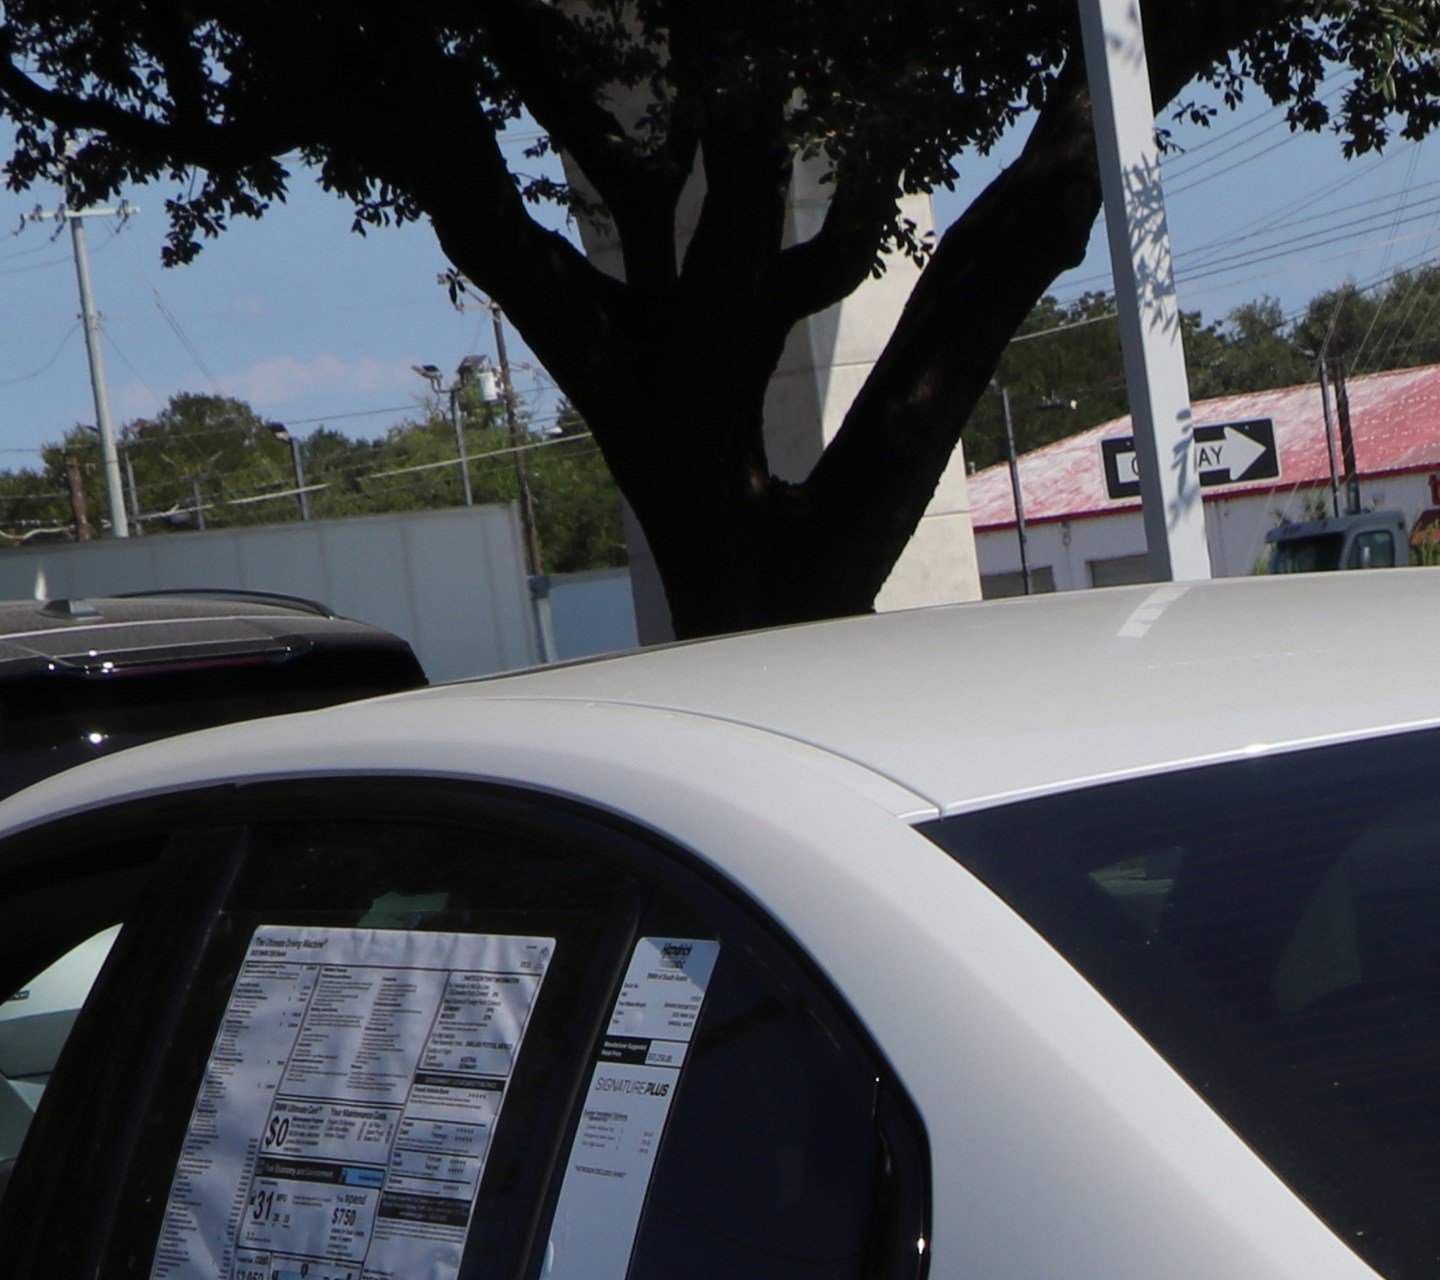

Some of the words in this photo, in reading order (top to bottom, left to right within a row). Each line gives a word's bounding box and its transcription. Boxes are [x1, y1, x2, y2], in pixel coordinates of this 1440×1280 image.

[1194, 445, 1223, 473] AY
[266, 1115, 289, 1148] $0
[253, 1190, 274, 1220] 31
